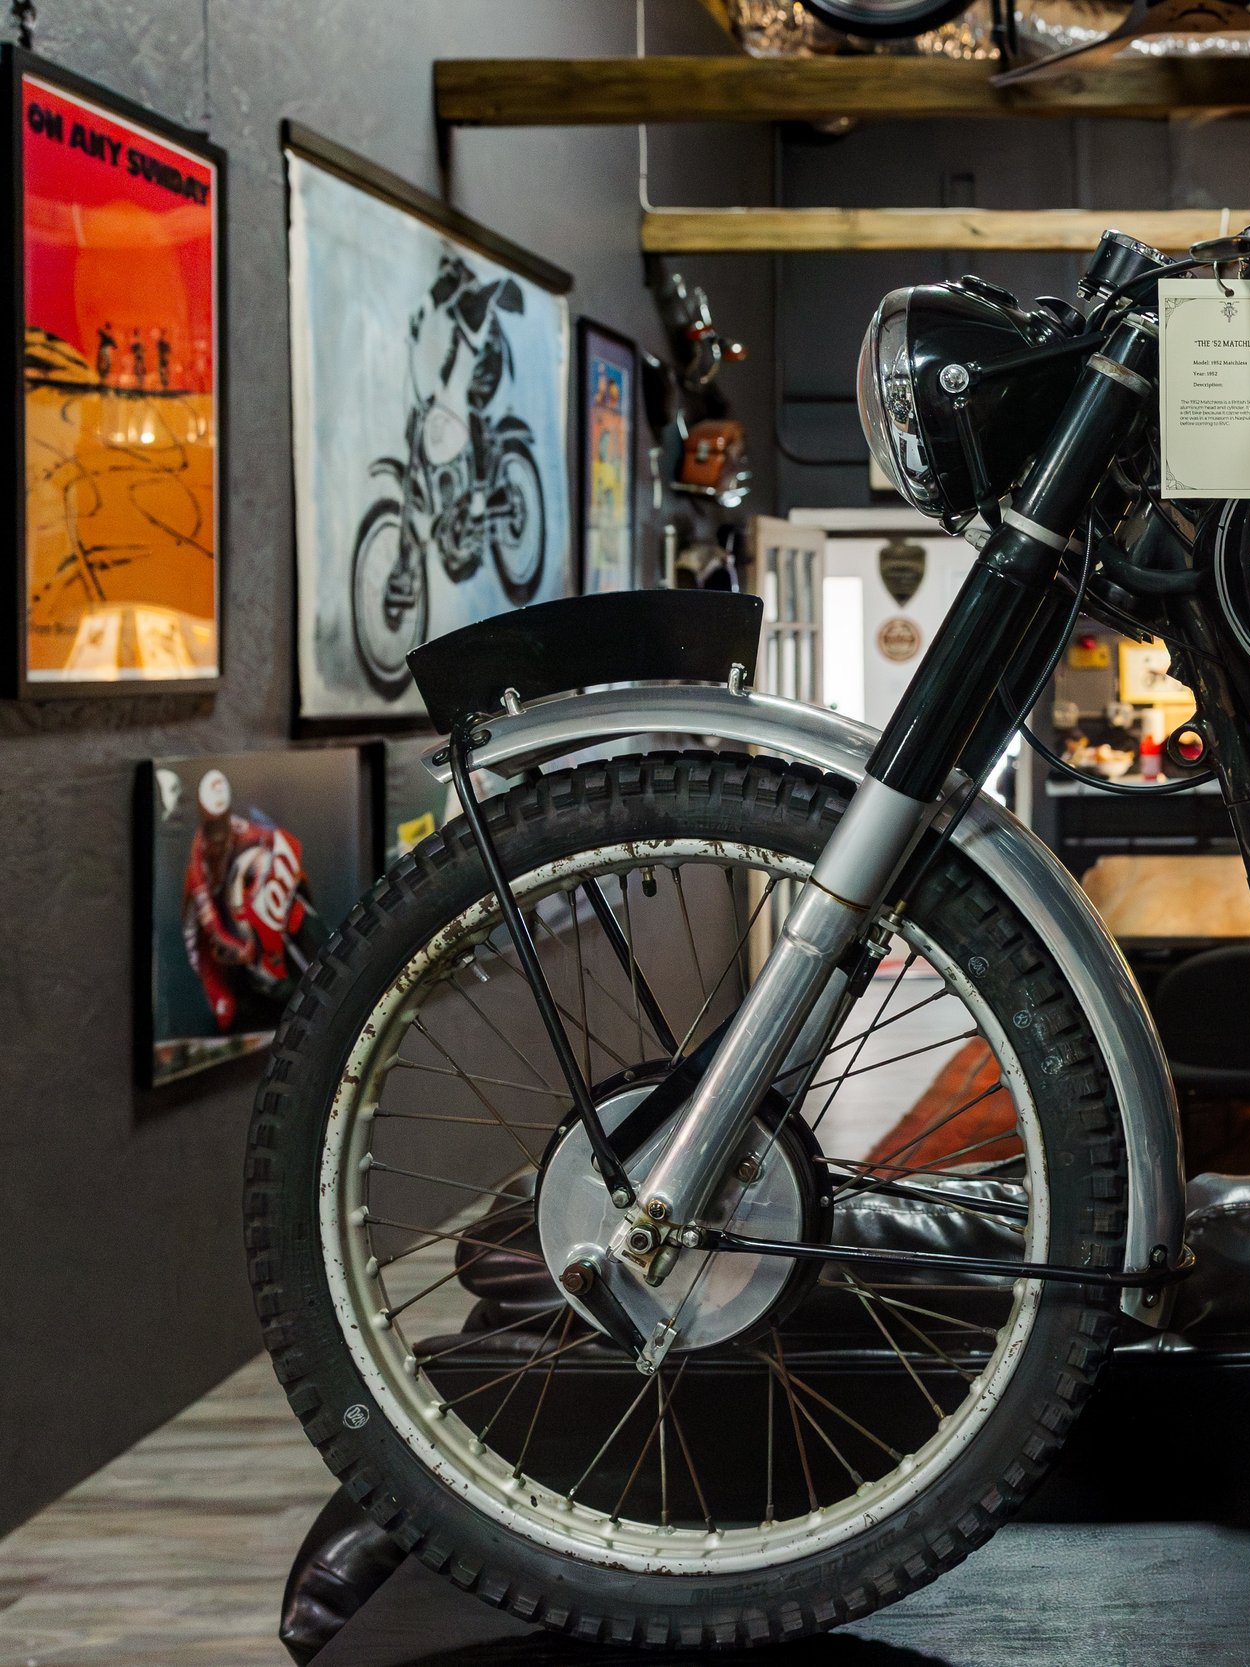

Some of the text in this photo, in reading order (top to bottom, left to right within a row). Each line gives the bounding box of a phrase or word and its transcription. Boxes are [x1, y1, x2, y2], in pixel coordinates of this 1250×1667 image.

[27, 102, 210, 207] ON ANY SUNDAY
